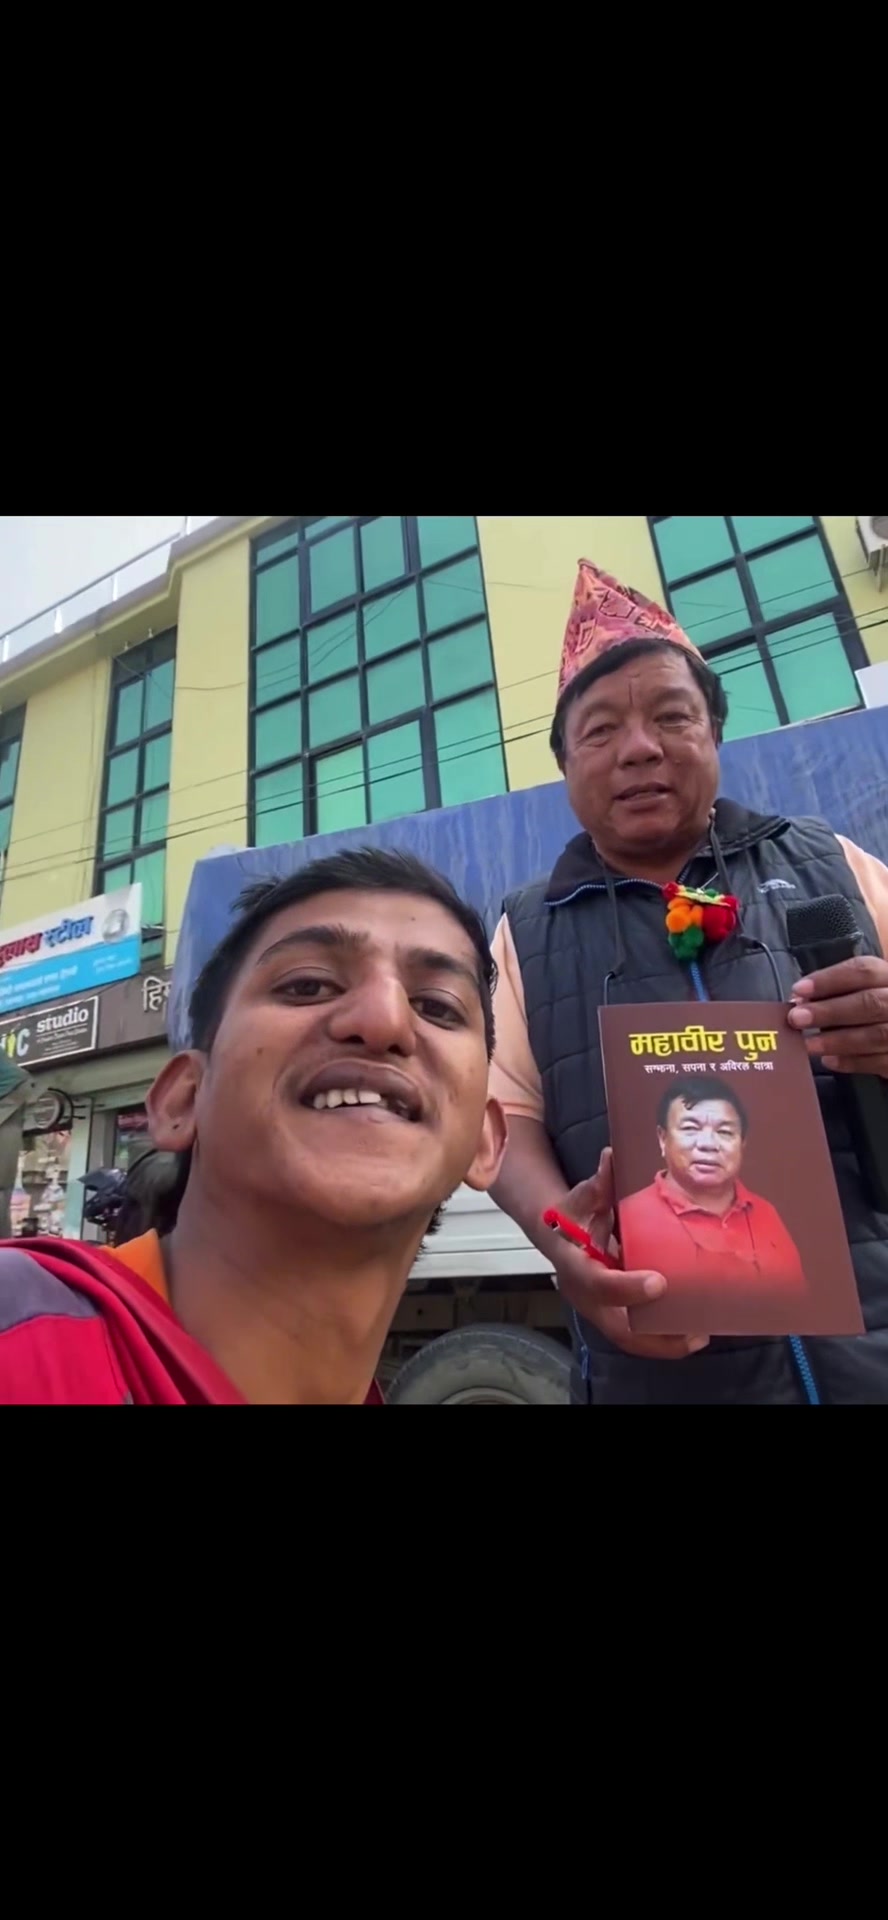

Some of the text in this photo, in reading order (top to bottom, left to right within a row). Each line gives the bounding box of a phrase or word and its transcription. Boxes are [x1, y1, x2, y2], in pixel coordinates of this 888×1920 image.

[36, 1007, 89, 1033] studio
[628, 1025, 779, 1061] महावीर पुन
[682, 1062, 707, 1073] सपना
[709, 1062, 717, 1072] र
[720, 1060, 750, 1071] अविरल
[753, 1061, 774, 1071] यात्रा
